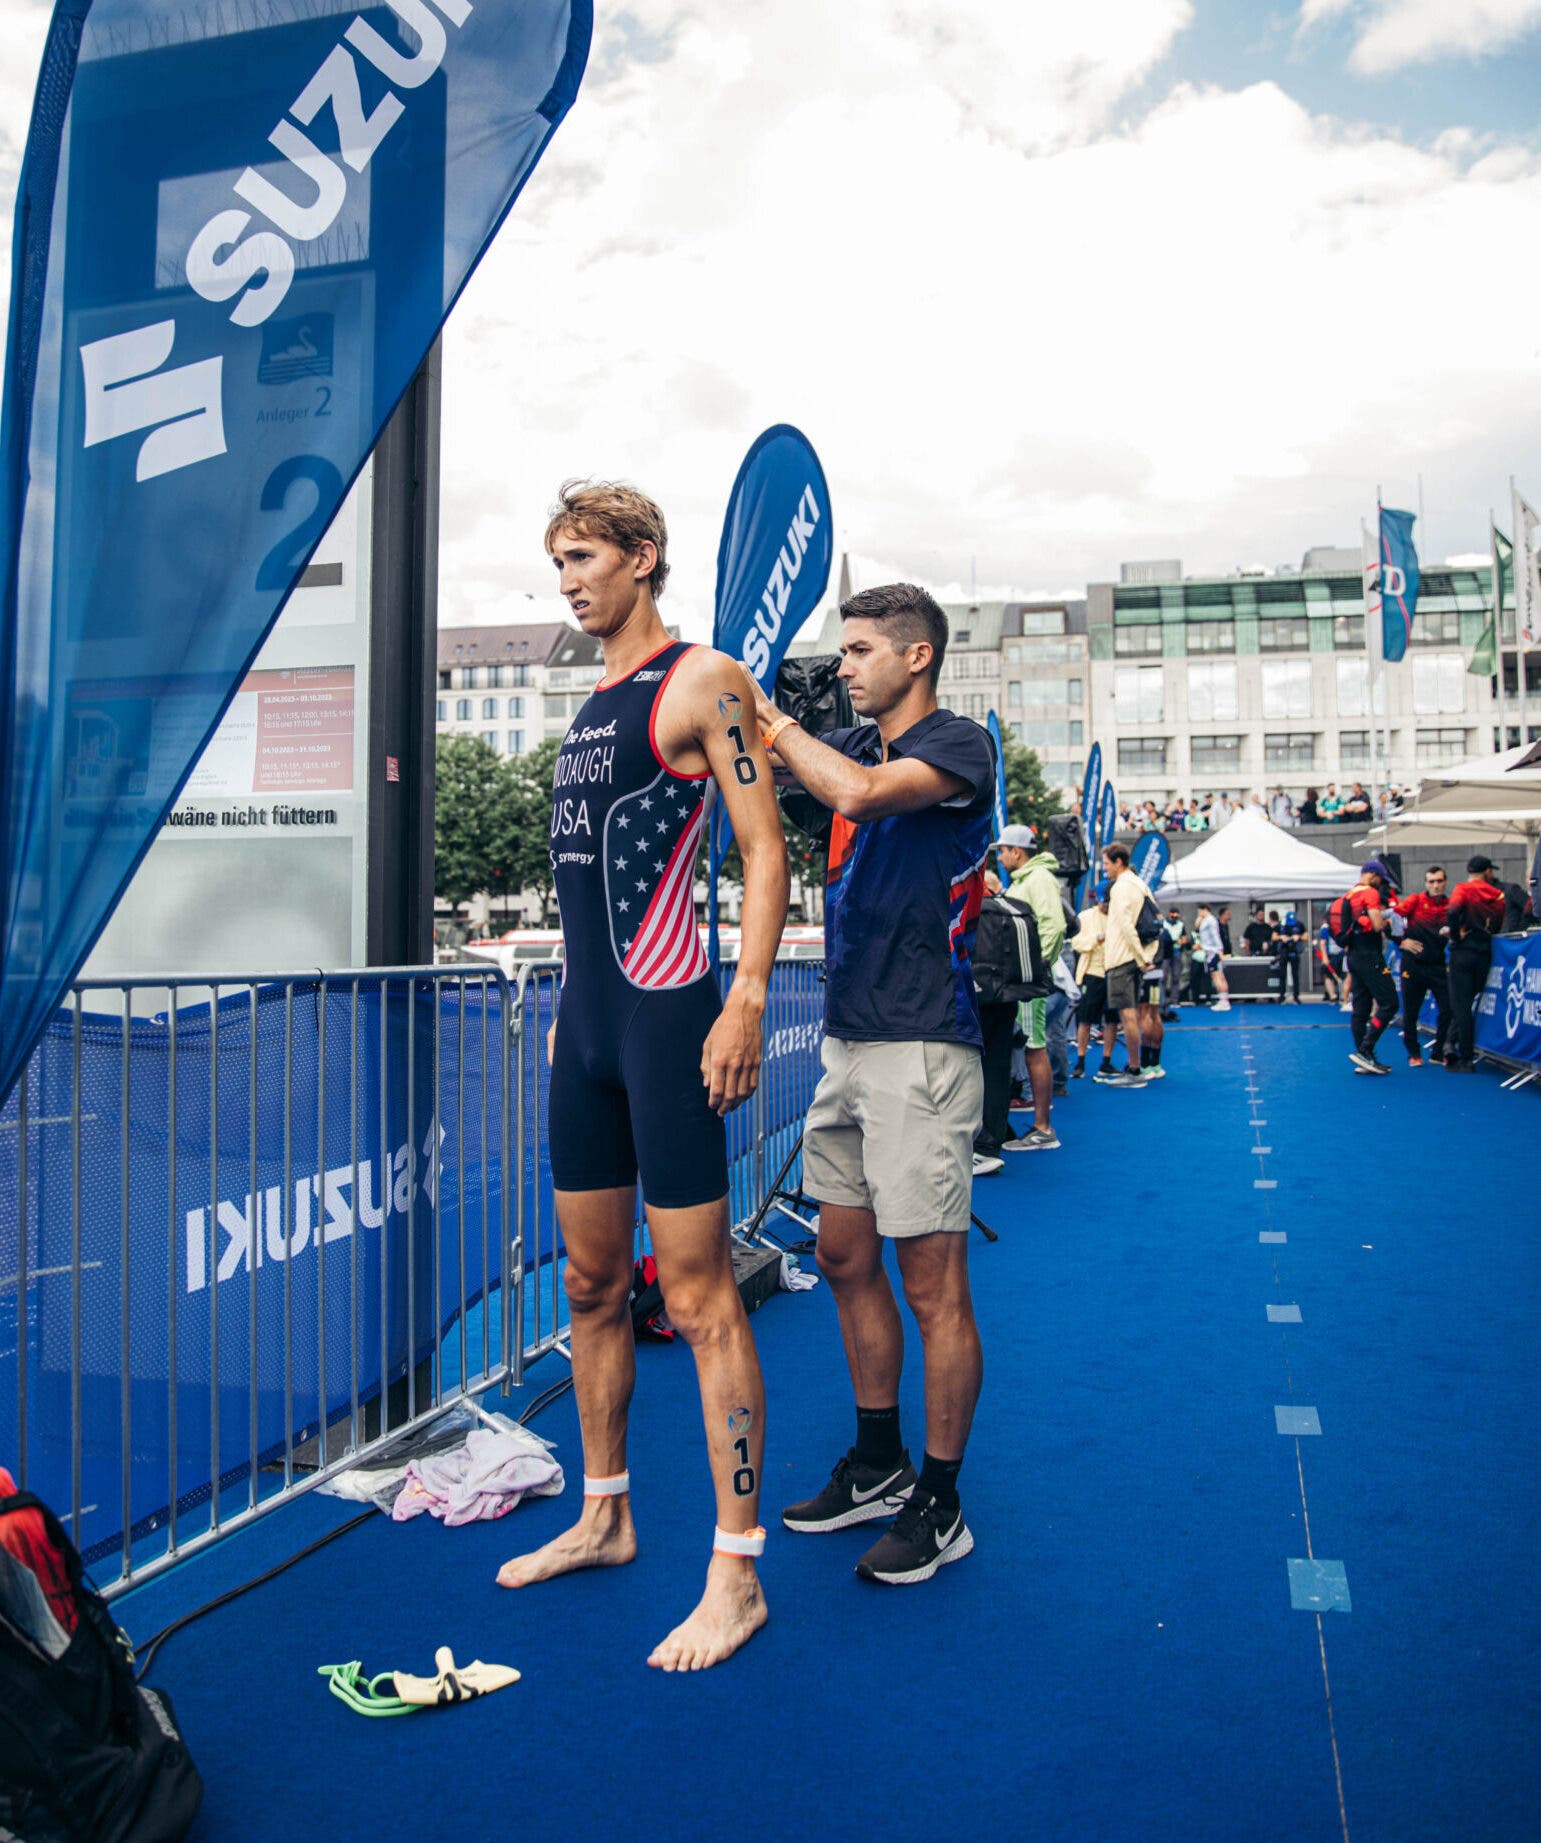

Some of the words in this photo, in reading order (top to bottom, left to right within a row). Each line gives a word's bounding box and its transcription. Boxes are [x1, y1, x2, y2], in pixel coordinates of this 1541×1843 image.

[743, 483, 820, 680] SUZUKI
[578, 719, 617, 743] Feed.
[554, 745, 615, 789] DDAUGH
[726, 723, 758, 786] 10
[221, 806, 268, 827] nicht
[272, 804, 338, 826] füttern
[550, 798, 592, 839] USA
[558, 852, 596, 865] synergy
[731, 1436, 756, 1498] 10
